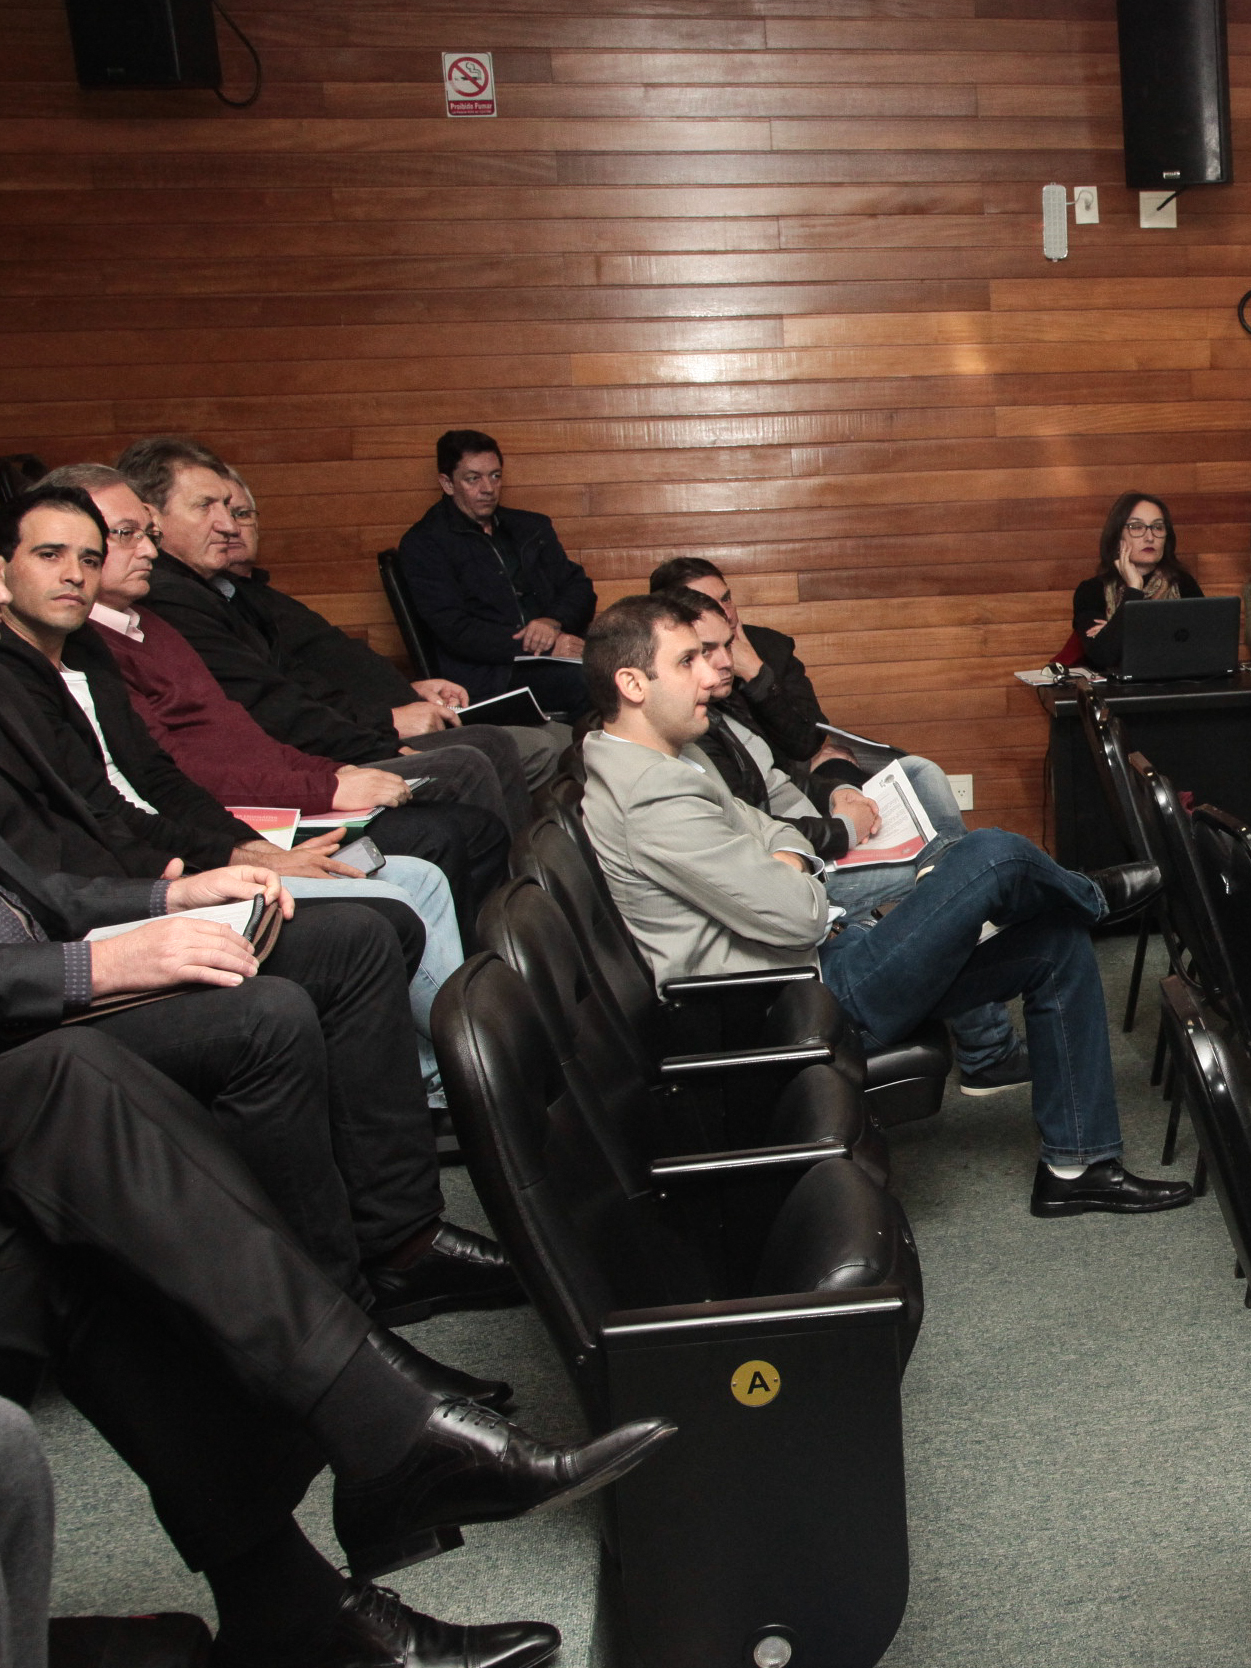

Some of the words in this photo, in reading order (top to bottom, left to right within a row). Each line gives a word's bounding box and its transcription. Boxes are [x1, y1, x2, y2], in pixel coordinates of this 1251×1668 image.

[450, 102, 473, 110] Proibido
[474, 102, 492, 110] Fumar
[747, 1371, 771, 1394] A
